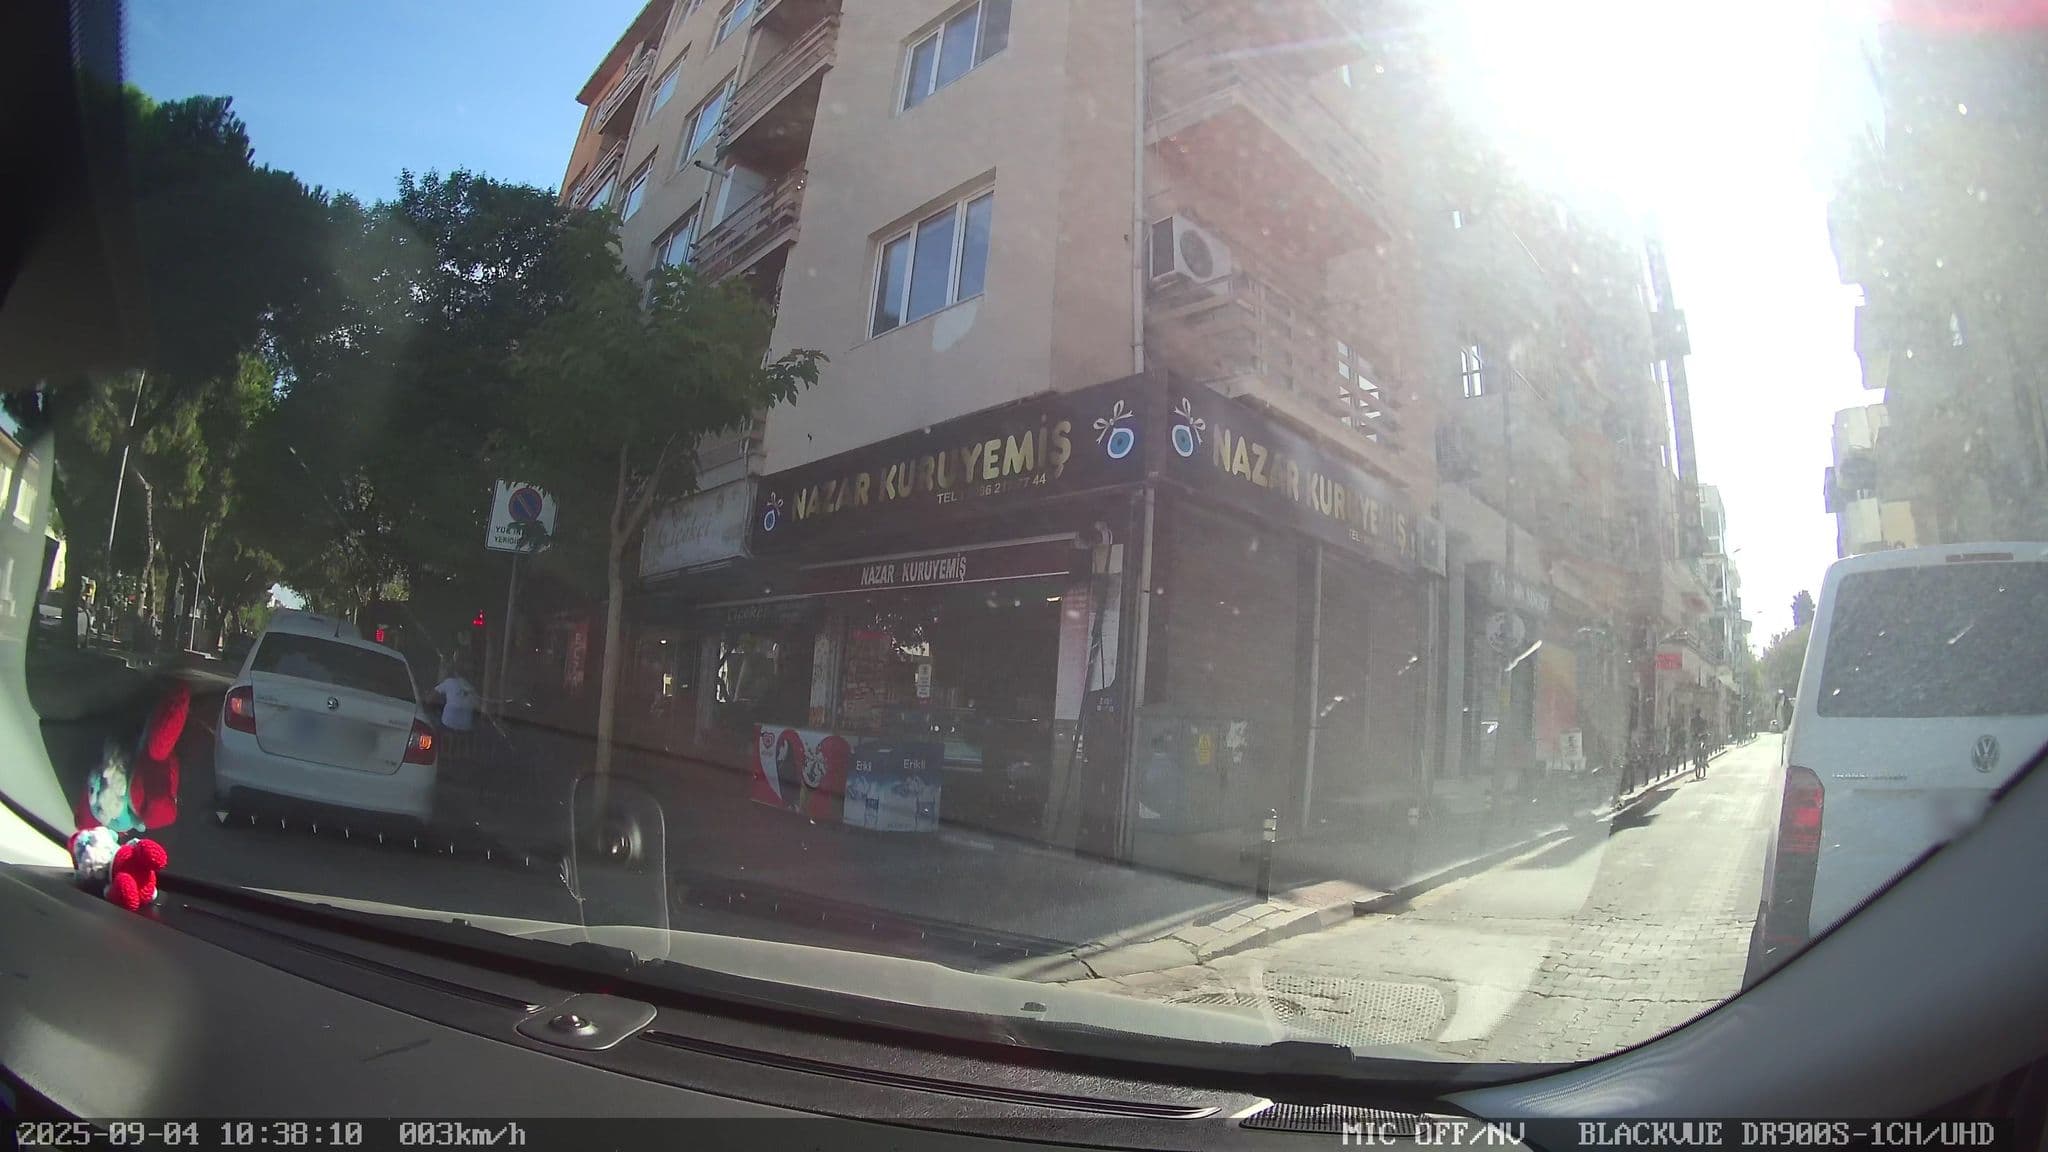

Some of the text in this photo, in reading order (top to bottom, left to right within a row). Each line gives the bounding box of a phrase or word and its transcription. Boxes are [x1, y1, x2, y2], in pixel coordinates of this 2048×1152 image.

[791, 414, 1071, 522] NAZAR KURUYEMİŞ
[1213, 423, 1408, 556] NAZAR KURYEİŞ
[860, 553, 967, 586] NAZAR KURUYEMİŞ
